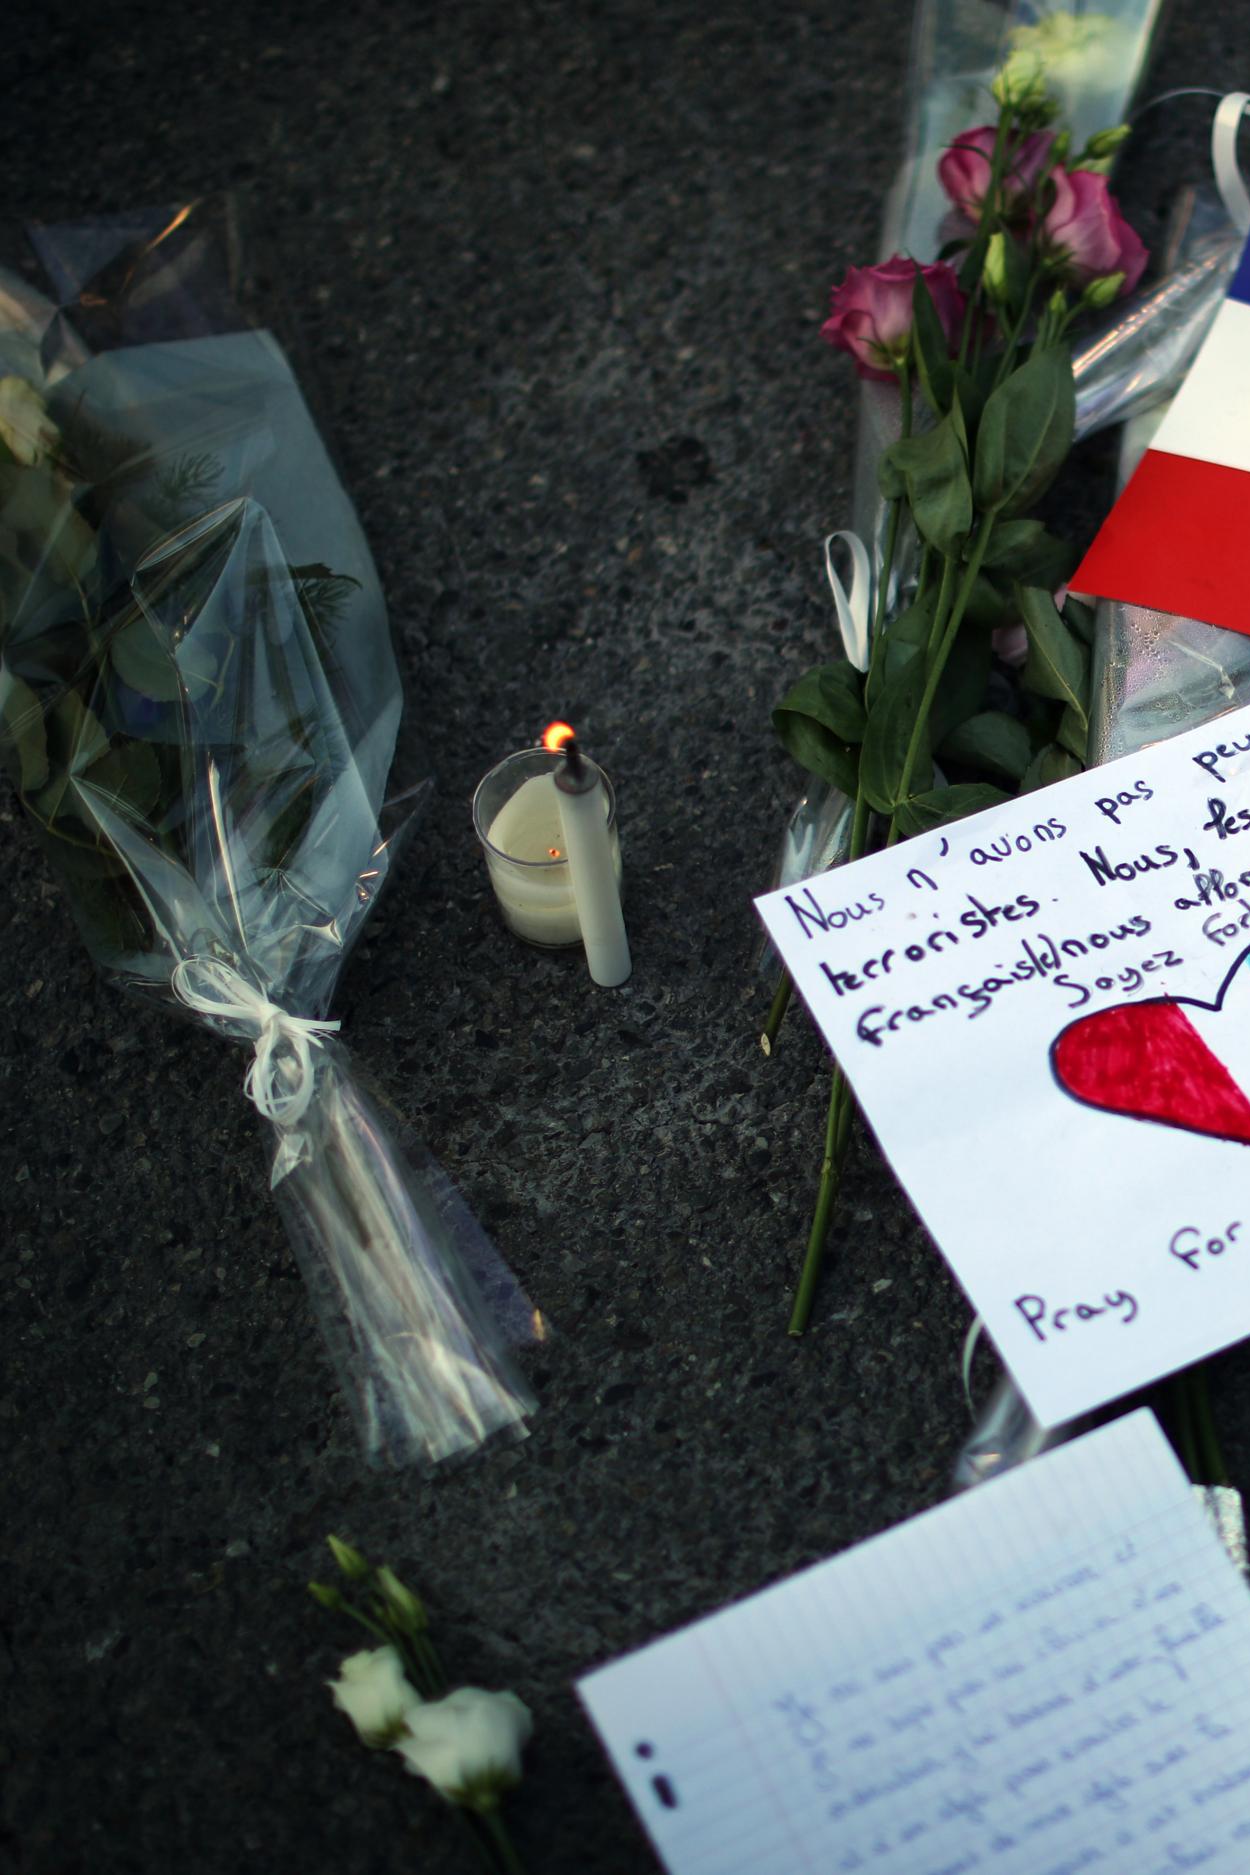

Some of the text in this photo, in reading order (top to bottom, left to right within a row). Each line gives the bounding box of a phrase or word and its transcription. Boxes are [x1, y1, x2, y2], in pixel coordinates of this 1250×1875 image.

[784, 887, 886, 940] Nous
[1094, 780, 1154, 825] pas
[1078, 844, 1201, 887] Nous,
[1060, 914, 1153, 958] nous
[1053, 949, 1185, 1010] Soyez
[1013, 1290, 1139, 1342] Pray
